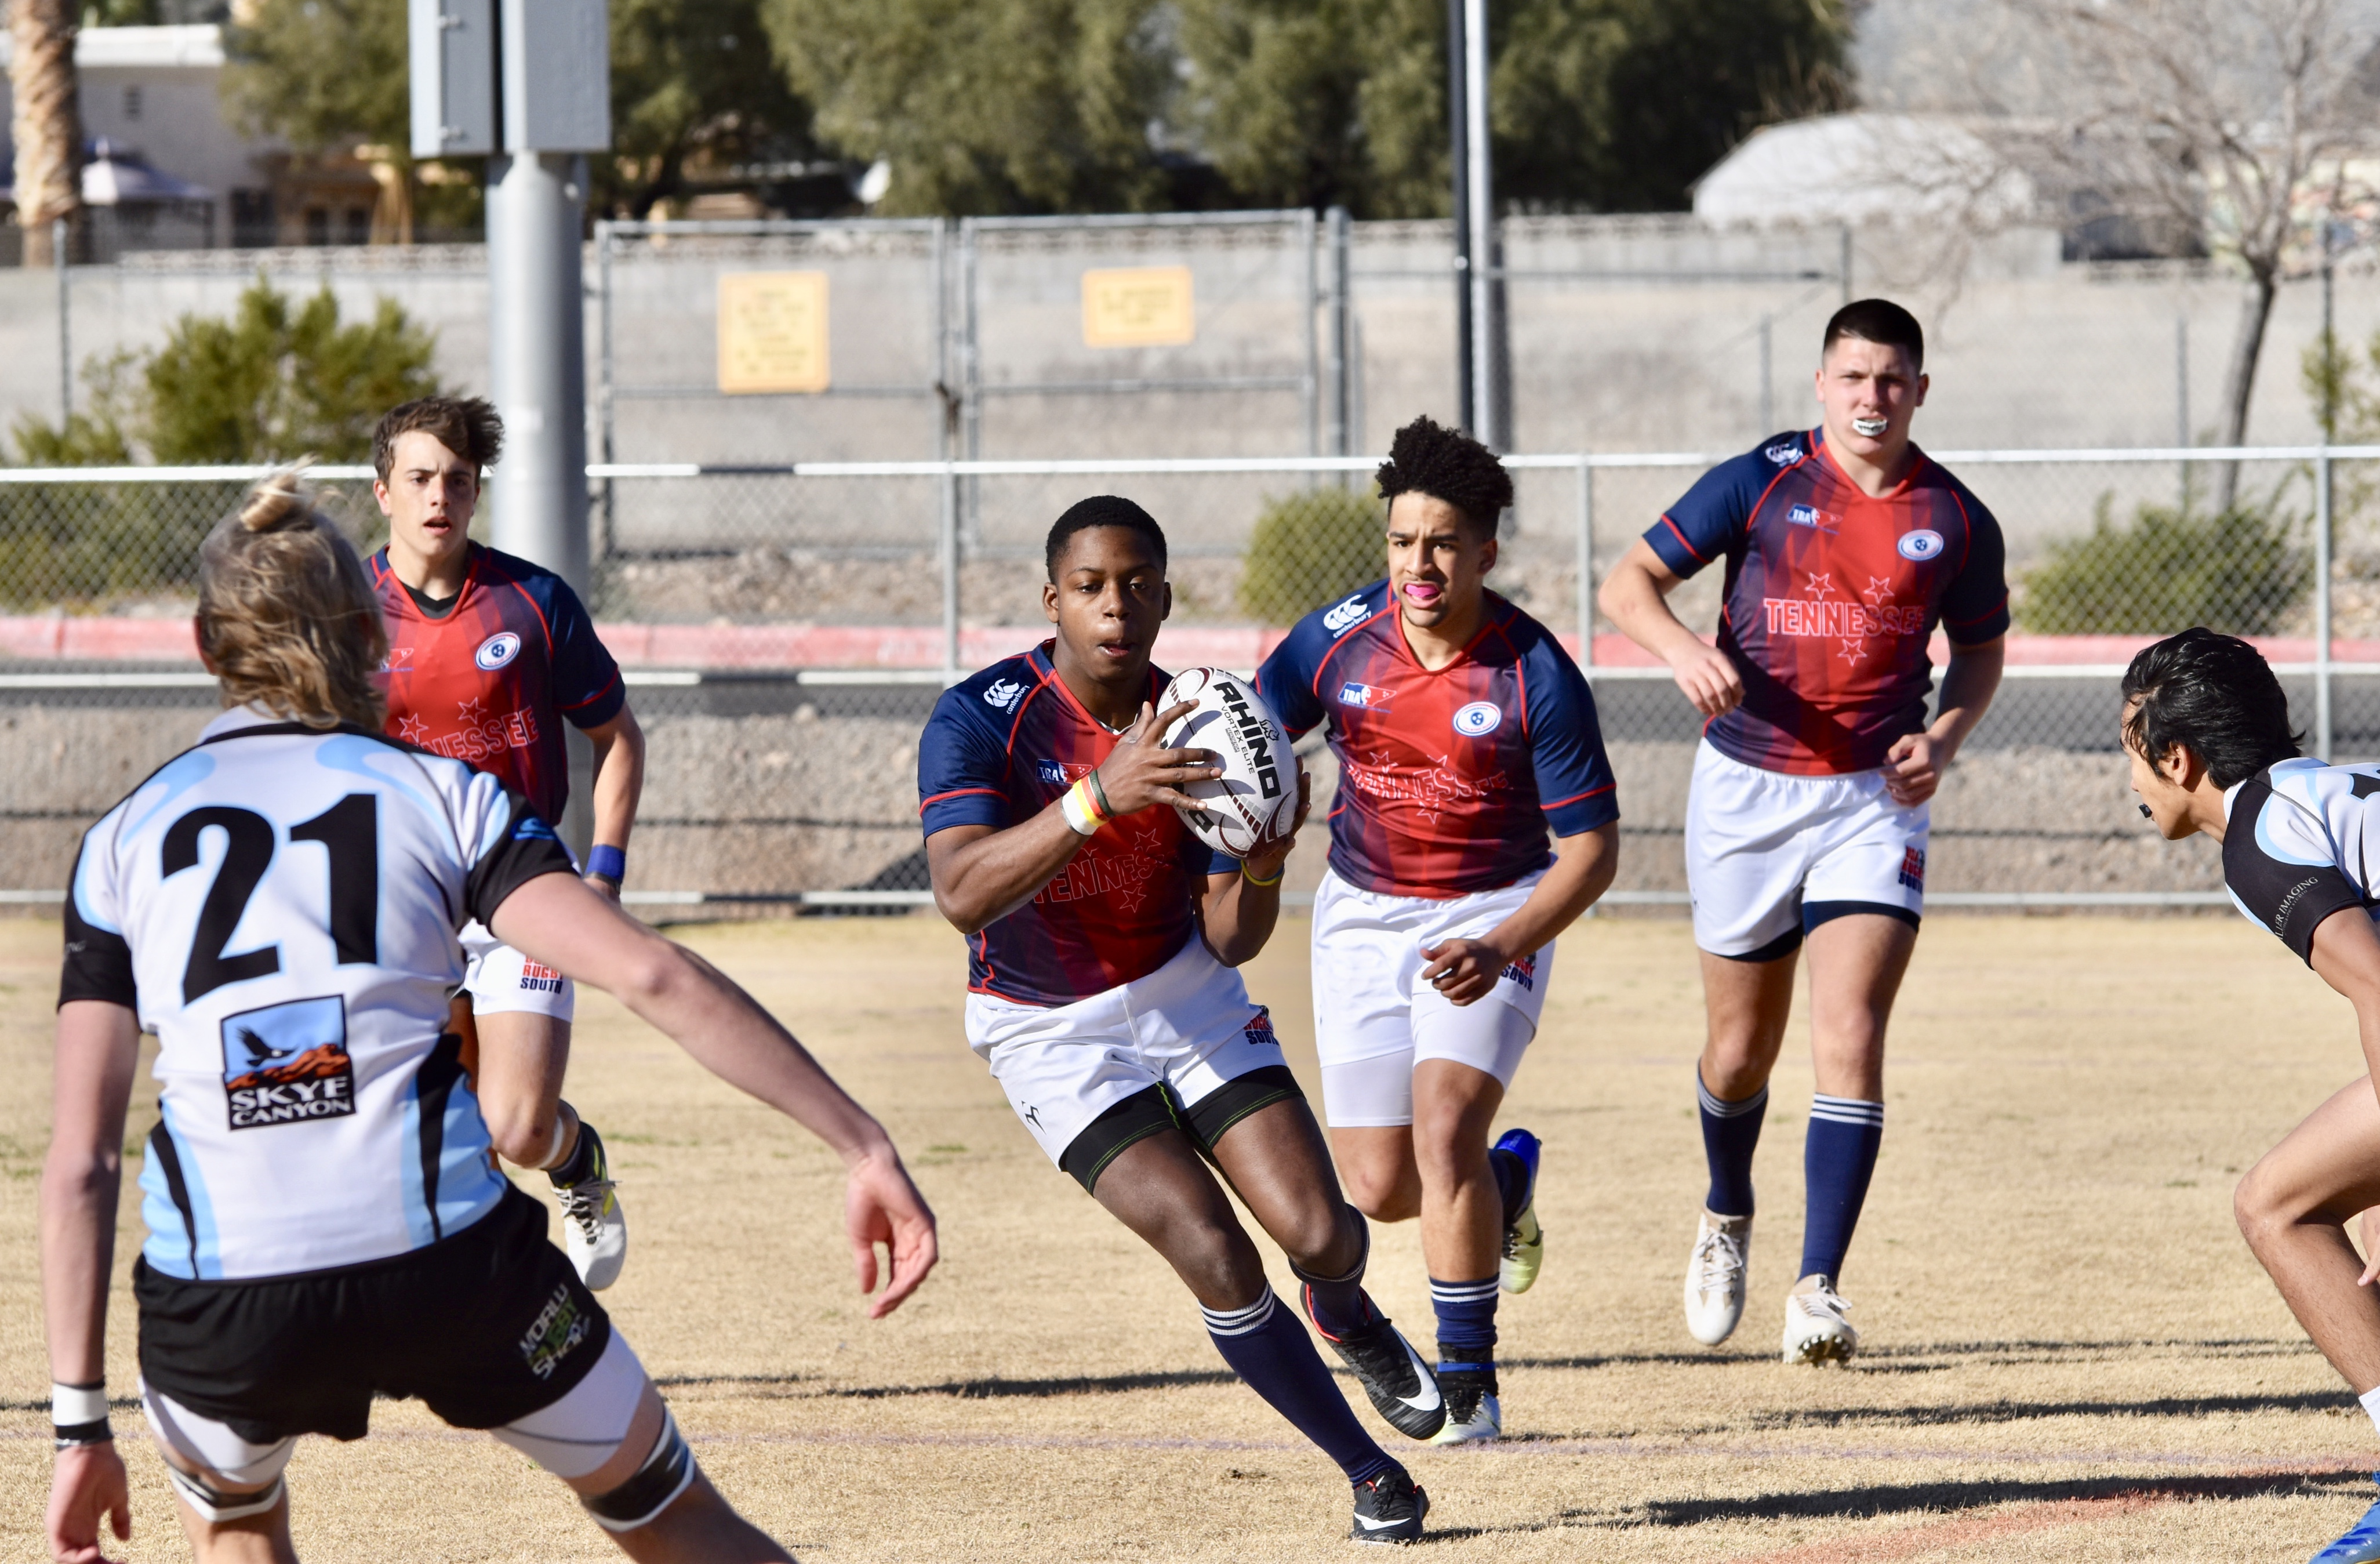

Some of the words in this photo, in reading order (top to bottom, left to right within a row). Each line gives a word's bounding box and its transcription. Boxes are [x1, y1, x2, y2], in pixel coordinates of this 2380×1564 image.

[1332, 610, 1372, 638] canterbury
[1763, 598, 1925, 637] TENNESSEE
[1006, 685, 1030, 714] canterbury
[1343, 688, 1361, 704] TRA
[420, 705, 539, 763] NESSEE
[1212, 681, 1281, 799] RHINO
[1221, 706, 1244, 743] VORTEX
[1241, 746, 1255, 774] ELITE
[1039, 767, 1060, 782] TRA
[162, 793, 379, 1005] 21
[2279, 876, 2319, 914] IMAGING
[520, 977, 564, 995] SOUTH
[522, 964, 563, 980] RUGB
[231, 1076, 348, 1111] SKYE
[232, 1098, 351, 1126] CANYON
